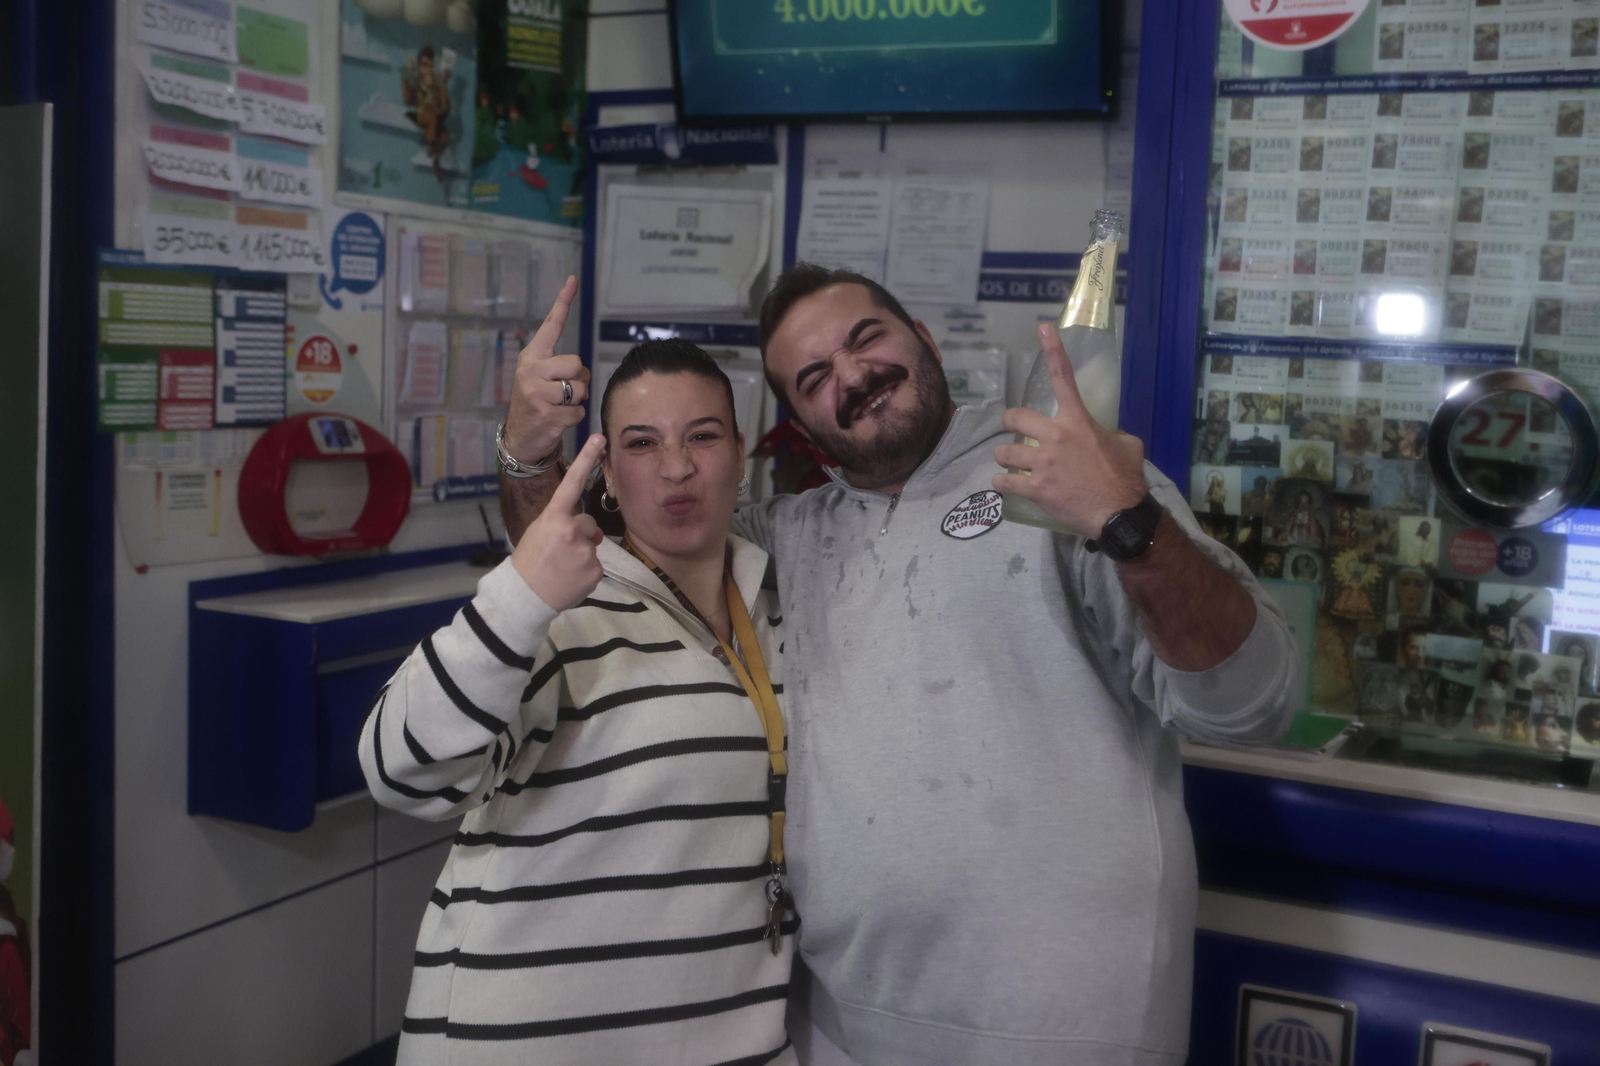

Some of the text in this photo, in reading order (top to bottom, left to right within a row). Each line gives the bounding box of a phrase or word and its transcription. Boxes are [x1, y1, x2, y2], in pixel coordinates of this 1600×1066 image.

[1088, 245, 1105, 291] Freixenet
[1009, 281, 1032, 297] DE
[304, 340, 333, 365] +18
[945, 502, 1001, 527] PEANUTS
[1502, 545, 1532, 561] +18
[1503, 556, 1529, 568] años
